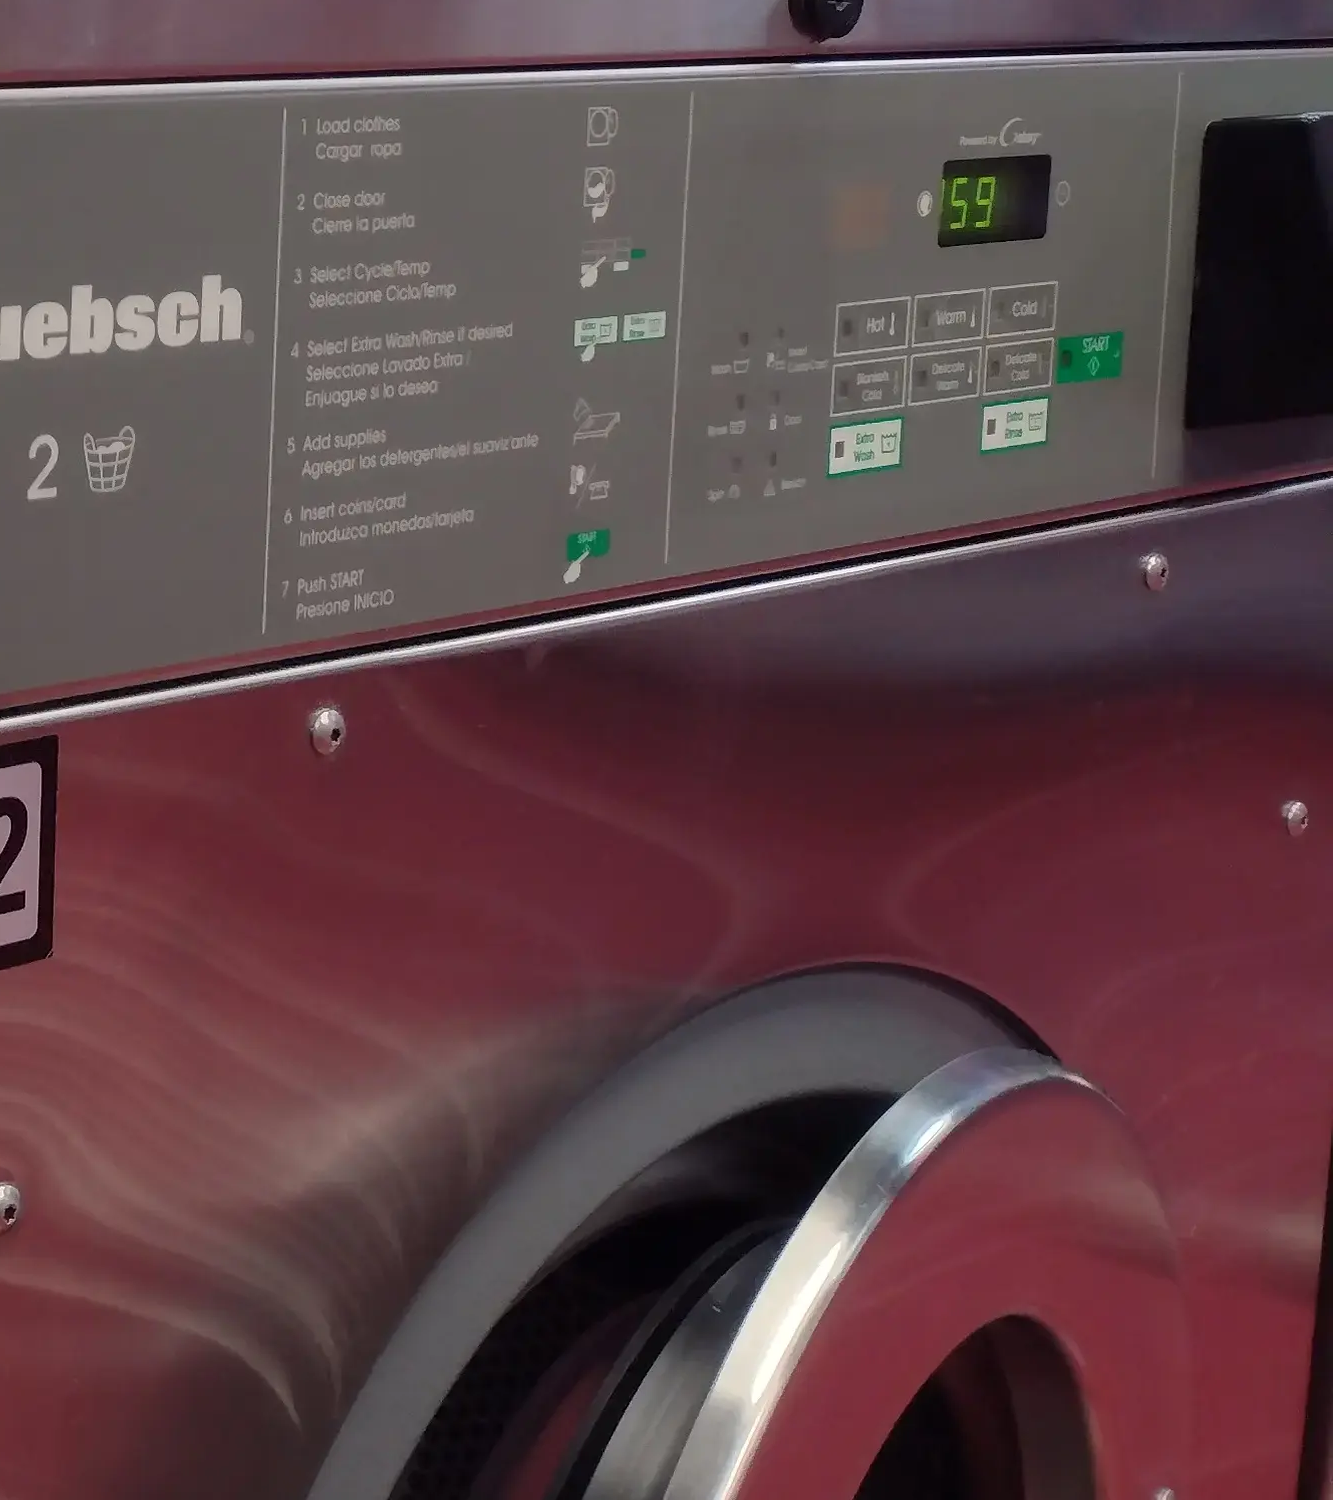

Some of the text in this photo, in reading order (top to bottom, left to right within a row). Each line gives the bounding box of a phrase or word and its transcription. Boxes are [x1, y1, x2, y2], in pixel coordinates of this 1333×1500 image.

[301, 115, 400, 135] 1 Load clothes
[315, 142, 402, 162] Cargar ropa
[297, 190, 386, 210] 2 Close door
[312, 213, 415, 234] Cierra la puerta
[294, 260, 431, 284] 3 Select Cycle/Temp
[309, 282, 456, 309] Seleccione Ciclo/Temp
[936, 310, 966, 326] Warm
[1012, 301, 1038, 317] Cold
[866, 317, 885, 334] Hot
[291, 322, 513, 357] 4 Select Extra Wash/Rinse if desired
[1083, 335, 1110, 354] START
[305, 360, 379, 382] Seleccione
[383, 356, 430, 374] Lavado
[433, 353, 462, 368] Extra
[305, 386, 367, 407] Enjuague
[383, 383, 394, 398] lo
[398, 380, 438, 396] desea
[287, 428, 386, 454] 5 Add supplies
[27, 434, 59, 500] 2
[302, 458, 355, 479] Agregar
[360, 453, 376, 468] los
[473, 433, 539, 454] suavizante
[284, 493, 407, 524] 6 Insert coins/card
[300, 508, 474, 546] Introduzca monedas/tarjeta
[282, 569, 364, 597] 7 Push START
[296, 589, 394, 620] Presione INICIO
